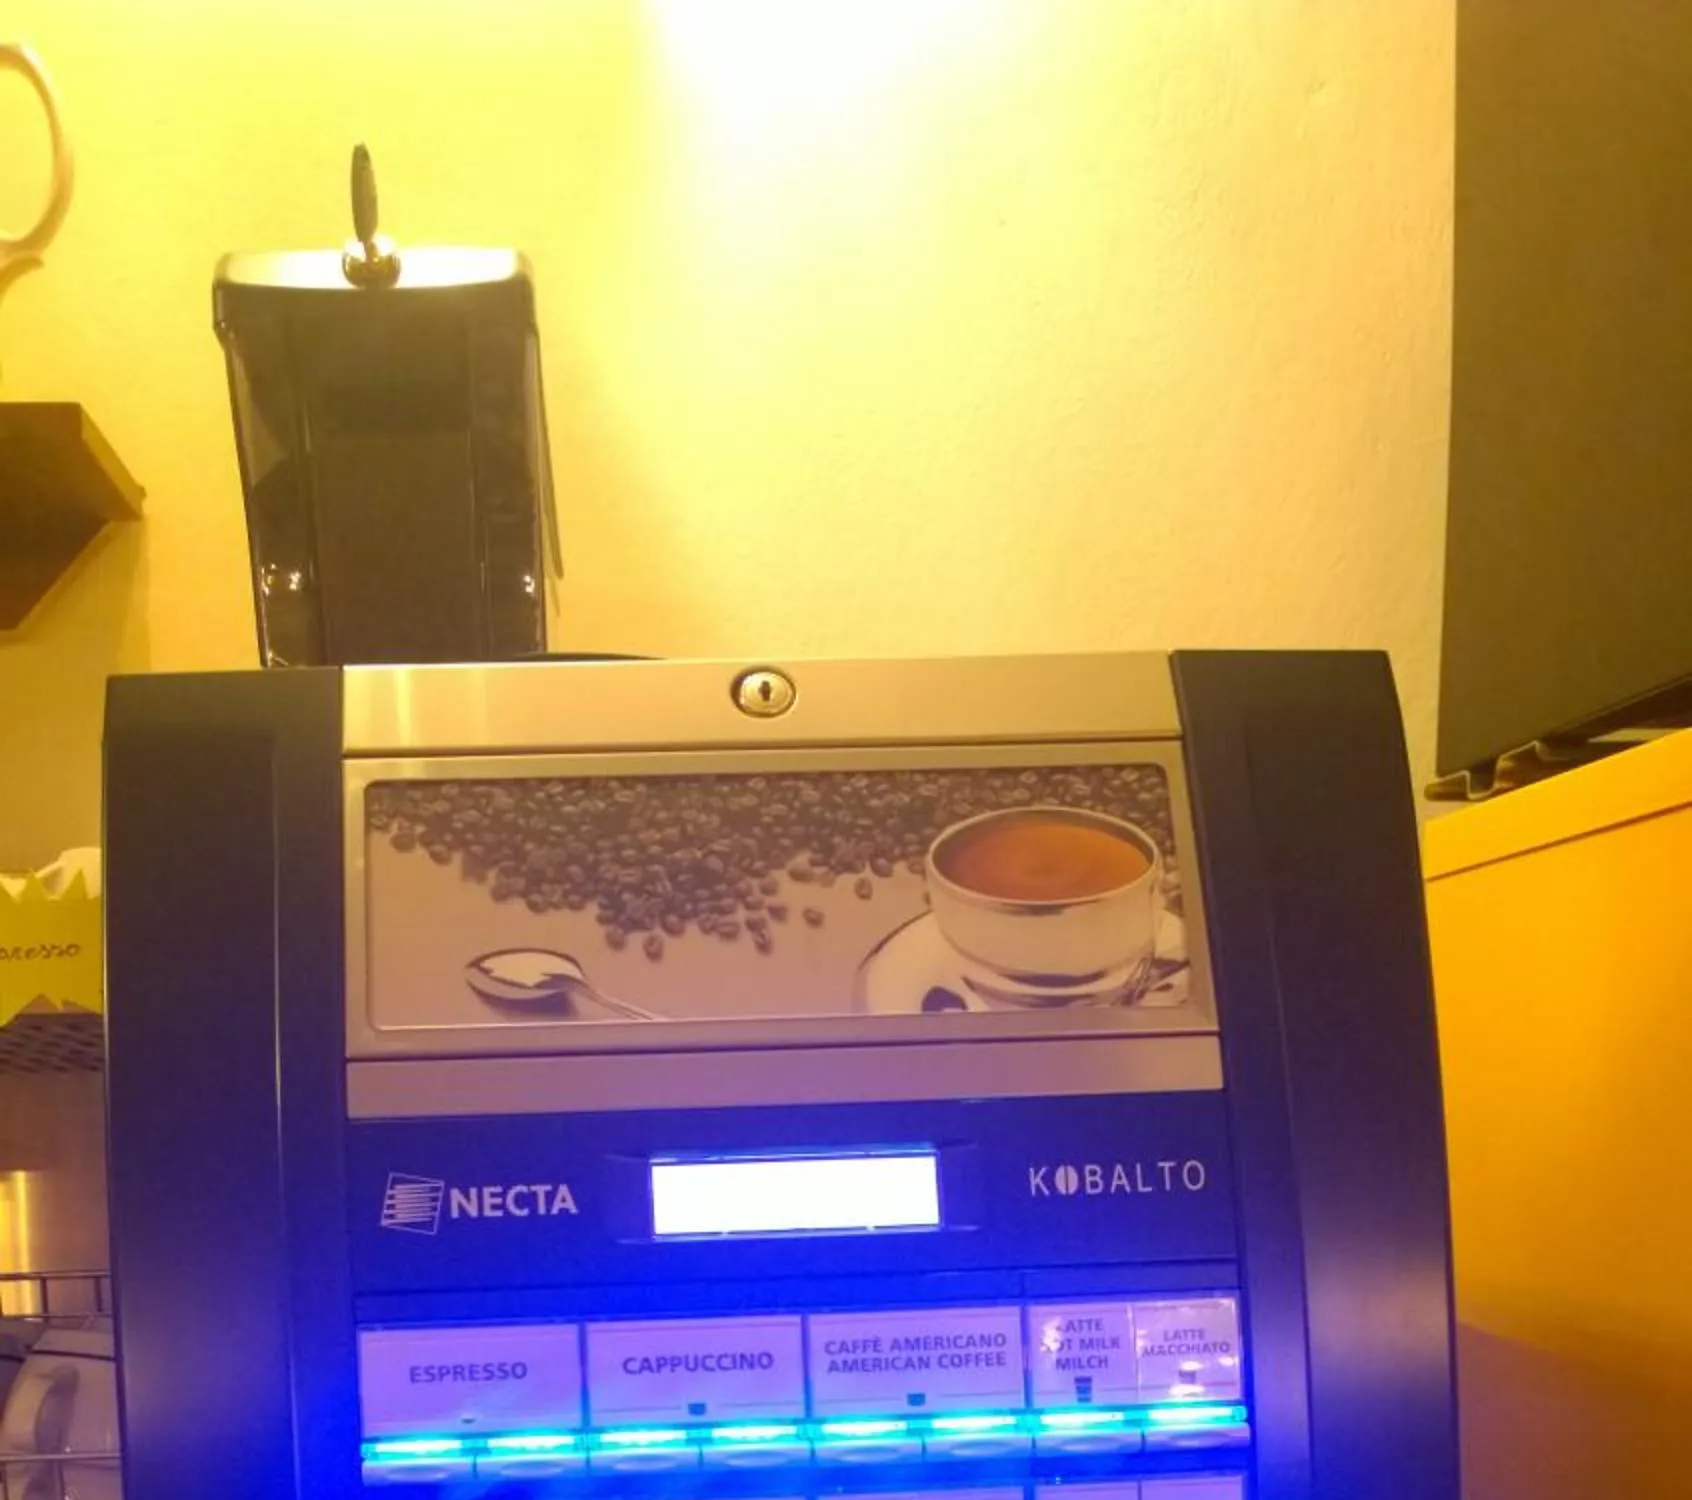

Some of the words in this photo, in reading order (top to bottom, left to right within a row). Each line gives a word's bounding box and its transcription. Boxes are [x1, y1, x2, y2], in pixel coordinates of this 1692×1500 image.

[1029, 1159, 1205, 1197] KOBALTO
[449, 1184, 579, 1218] NECTA
[1056, 1317, 1104, 1333] ATTE
[1163, 1328, 1207, 1343] LATTE
[890, 1332, 1007, 1351] AMERICANO
[1079, 1336, 1121, 1351] MILK
[409, 1361, 528, 1384] ESPRESSO
[622, 1351, 775, 1376] CAPPUCCINO
[827, 1355, 931, 1374] AMERICAN
[937, 1351, 1007, 1370] COFFEE
[1055, 1355, 1109, 1372] MILCH
